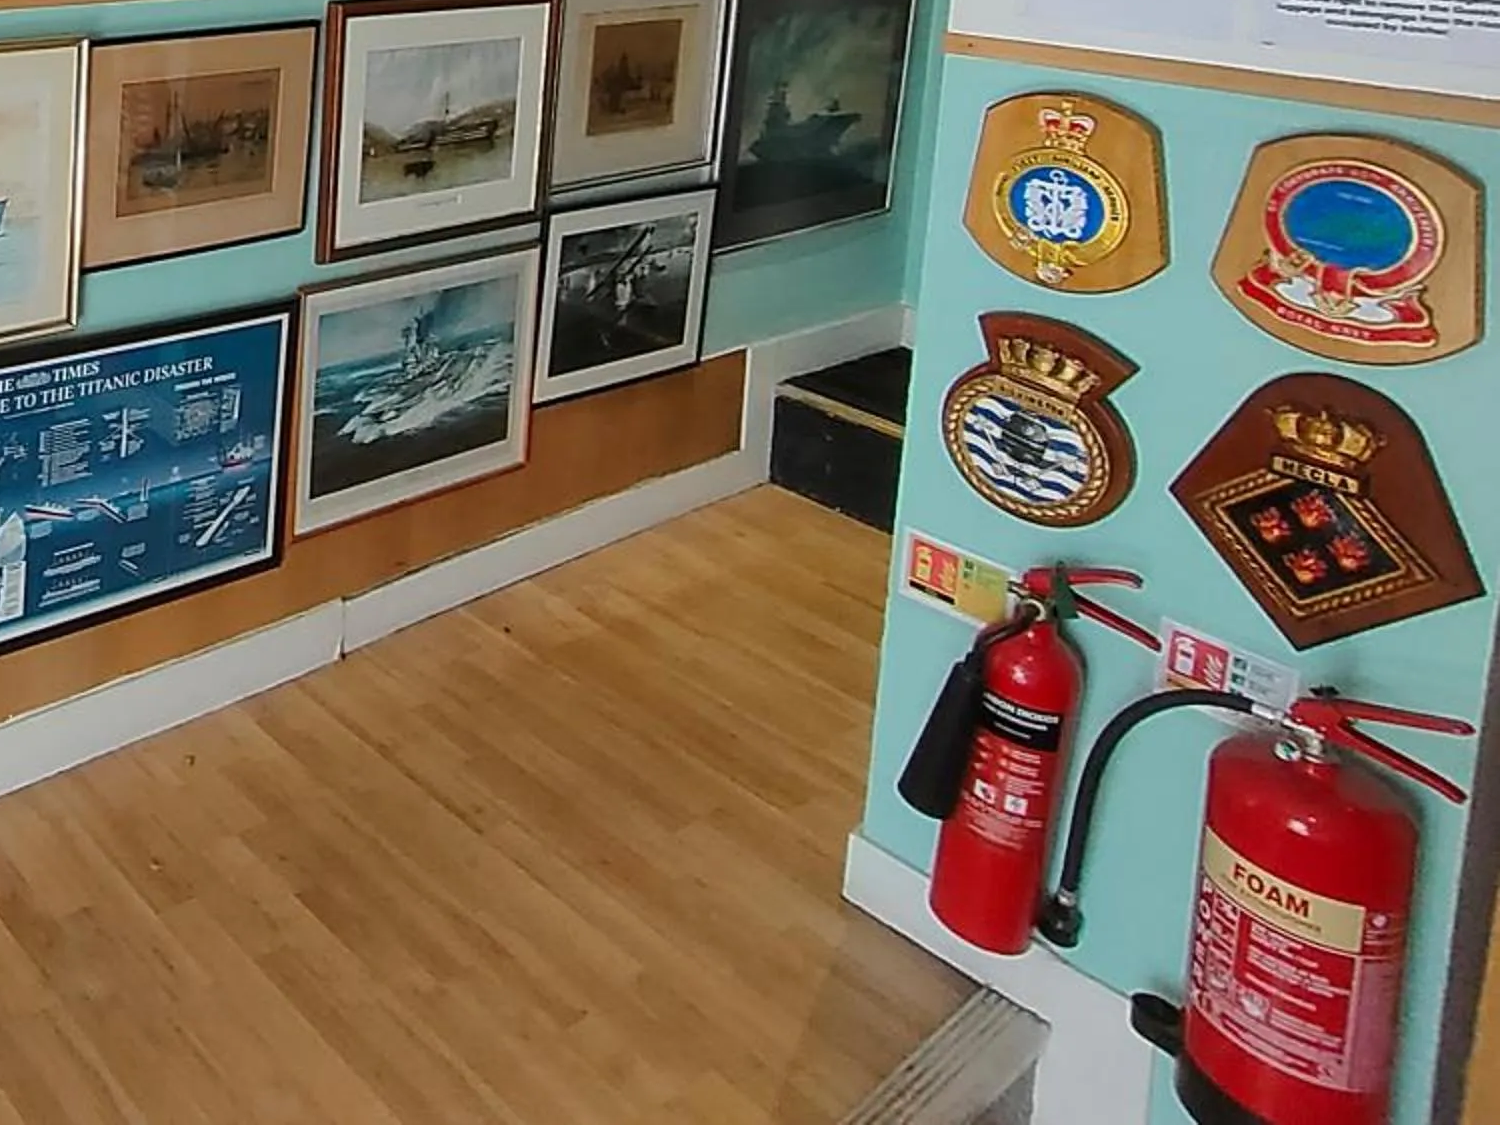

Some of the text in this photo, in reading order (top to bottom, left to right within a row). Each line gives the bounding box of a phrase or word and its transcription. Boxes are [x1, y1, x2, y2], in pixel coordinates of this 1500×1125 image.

[15, 393, 38, 412] TO
[42, 386, 75, 407] THE
[78, 371, 141, 400] TITANIC
[144, 356, 213, 384] DISASTER
[52, 361, 101, 382] TIMES
[1233, 862, 1310, 918] FOAM
